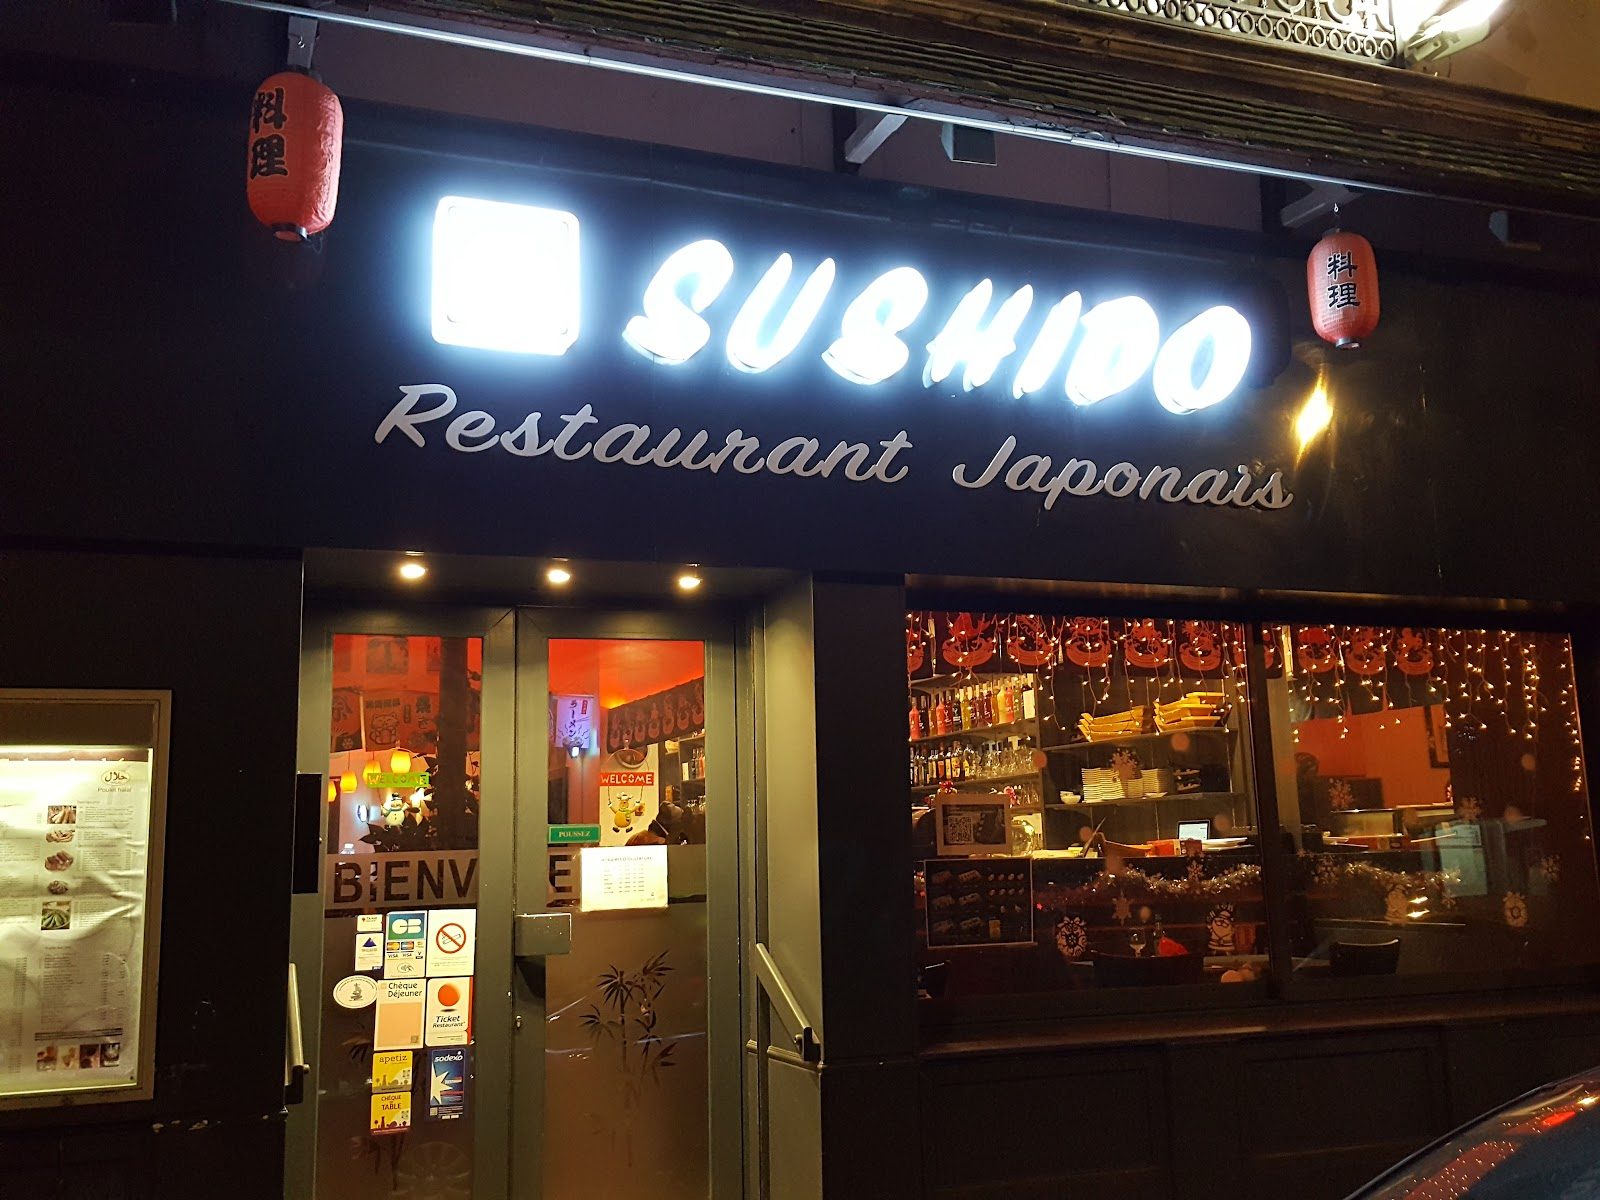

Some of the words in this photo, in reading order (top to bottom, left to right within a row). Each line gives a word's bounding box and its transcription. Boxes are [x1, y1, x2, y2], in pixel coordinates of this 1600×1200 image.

[251, 87, 288, 180] 料理
[1327, 251, 1361, 309] 料理
[622, 238, 1253, 414] SUSHIDO
[374, 383, 914, 483] Restaurant
[952, 435, 1294, 510] Japonais
[601, 773, 653, 785] WELCOME
[558, 830, 591, 838] POUSSEZ
[388, 990, 423, 998] Déjeuner
[436, 1015, 461, 1023] Ticket
[379, 1053, 408, 1064] apetiz
[434, 1051, 464, 1062] sodexo
[381, 1103, 402, 1111] TABLE
